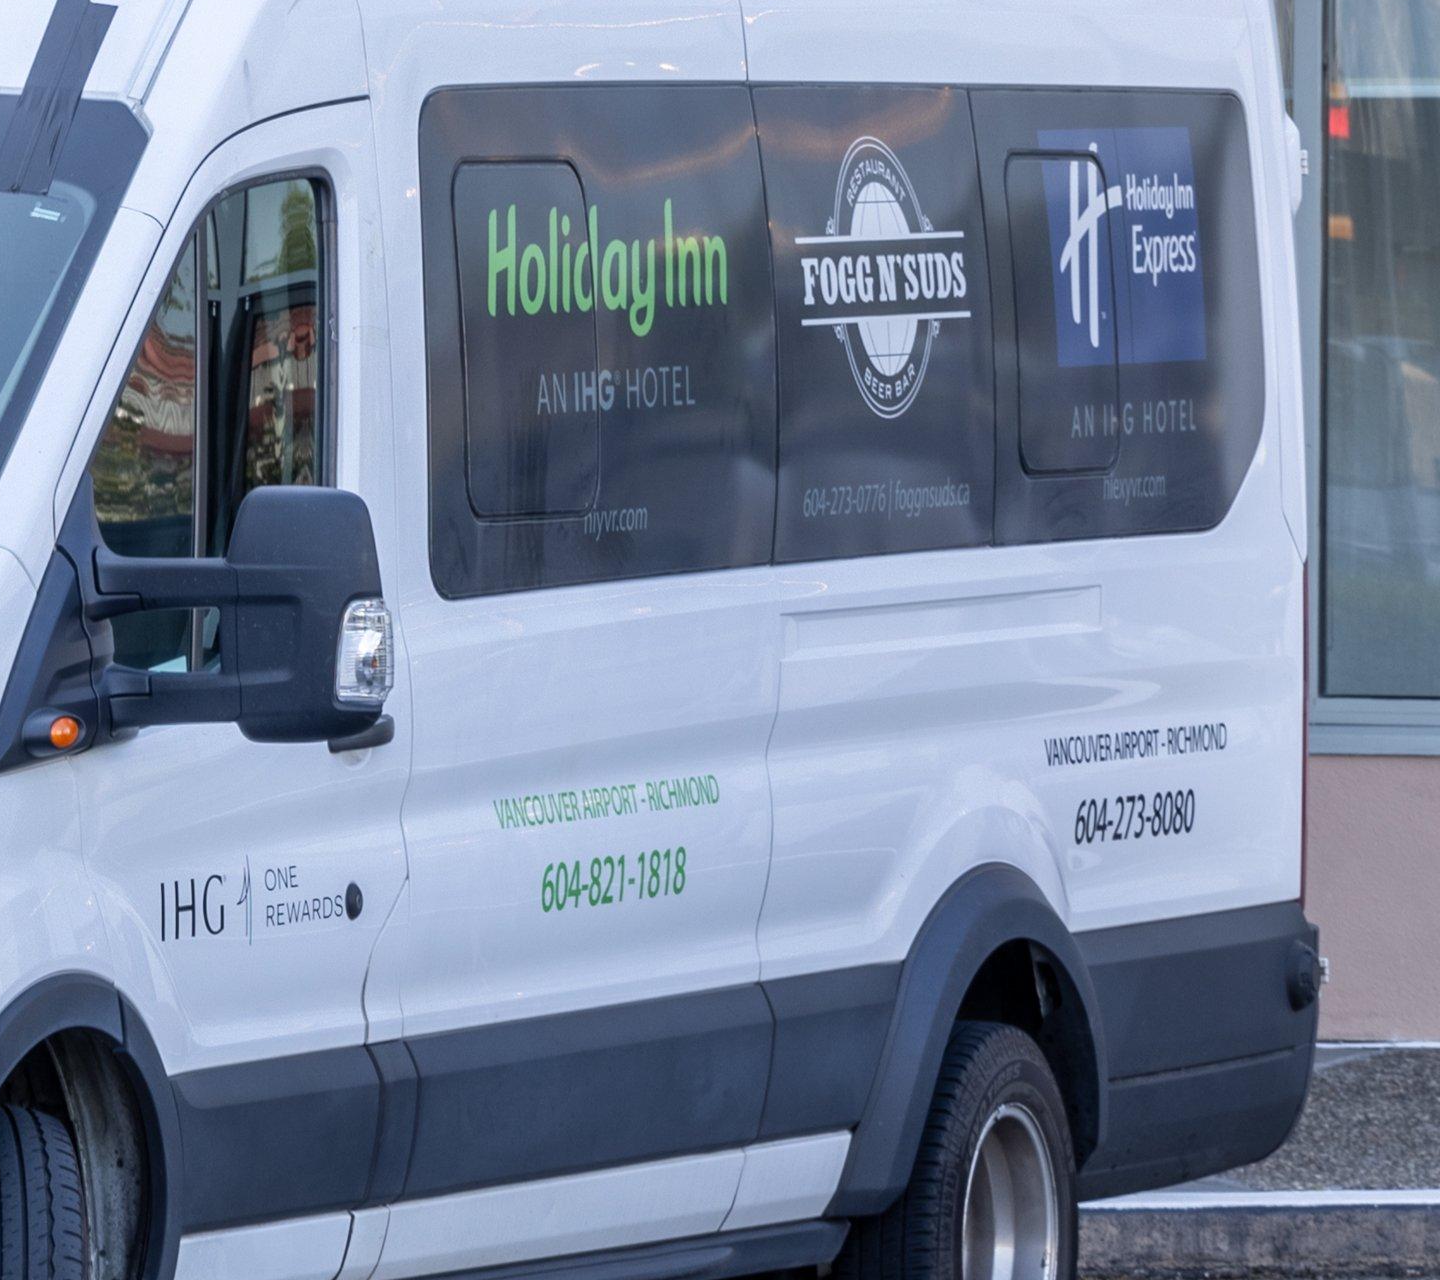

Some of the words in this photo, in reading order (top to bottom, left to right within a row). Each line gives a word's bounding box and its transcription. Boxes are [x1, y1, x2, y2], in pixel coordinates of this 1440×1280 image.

[846, 158, 907, 207] RESTAURANT
[1126, 174, 1173, 219] Holiday
[1174, 172, 1194, 210] Inn
[487, 203, 655, 337] Holiday
[663, 197, 728, 308] Inn
[800, 255, 875, 306] FOGG
[876, 251, 968, 302] N'SUDS
[1131, 224, 1196, 287] Express
[537, 373, 568, 415] AN
[626, 365, 696, 410] HOTEL
[864, 366, 894, 400] BEER
[894, 362, 917, 395] BAR
[1071, 405, 1094, 439] AN
[1142, 399, 1197, 434] HOTEL
[802, 484, 886, 518] 604-273-0776
[894, 476, 971, 518] foggnsuds.ca
[1044, 734, 1113, 766] VANCOUVER
[1113, 729, 1160, 760] AIRPORT
[1167, 723, 1228, 756] RICHMOND
[493, 791, 581, 829] VANCOUVER
[581, 784, 638, 819] AIRPORT
[646, 774, 721, 812] RICHMOND
[1074, 789, 1195, 845] 604-273-8080
[264, 865, 299, 891] ONE
[541, 846, 687, 913] 604-821-1818
[160, 874, 225, 942] IHG
[266, 895, 344, 927] REWARDS
